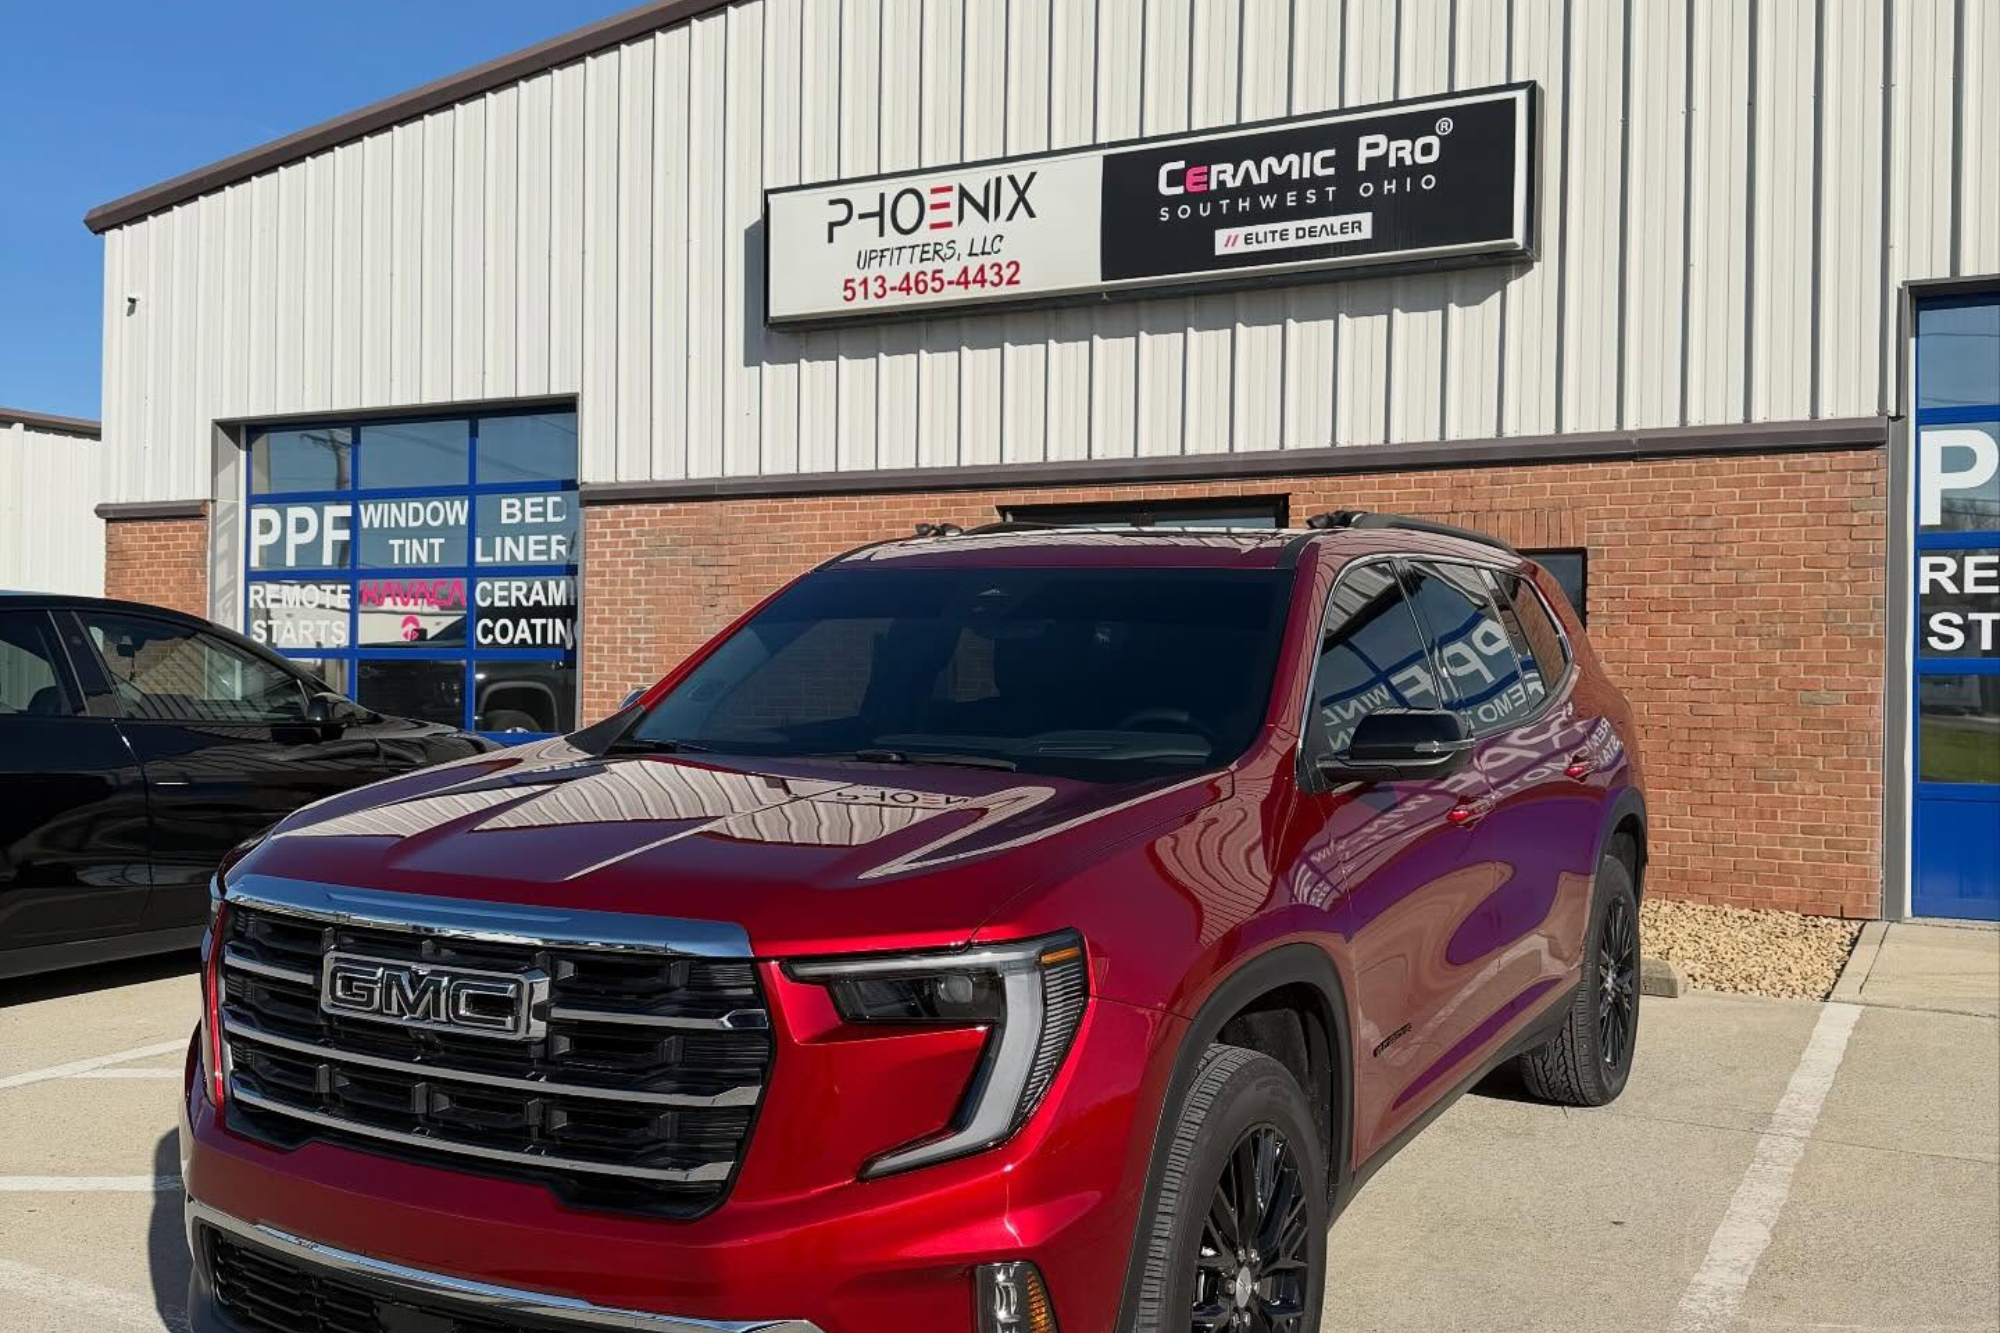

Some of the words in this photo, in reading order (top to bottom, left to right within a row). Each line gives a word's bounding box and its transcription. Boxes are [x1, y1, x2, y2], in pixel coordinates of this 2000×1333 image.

[1158, 147, 1337, 196] CERAMIC
[827, 171, 1038, 243] PHOENIX
[1159, 187, 1337, 221] SOUTHWEST
[1359, 174, 1437, 197] OHIO
[1244, 228, 1290, 245] ELITE
[1295, 220, 1362, 240] DEALER
[856, 239, 961, 270] UPFITTERS,
[967, 233, 1004, 257] LLC
[842, 260, 1021, 302] 513-465-4432
[359, 500, 469, 528] WINDOW
[500, 496, 567, 524] BED
[250, 505, 352, 567] PPF
[388, 538, 445, 564] TINT
[475, 534, 567, 562] LINER
[252, 619, 347, 645] STARTS
[475, 618, 578, 649] COATIN
[328, 962, 521, 1031] GMC
